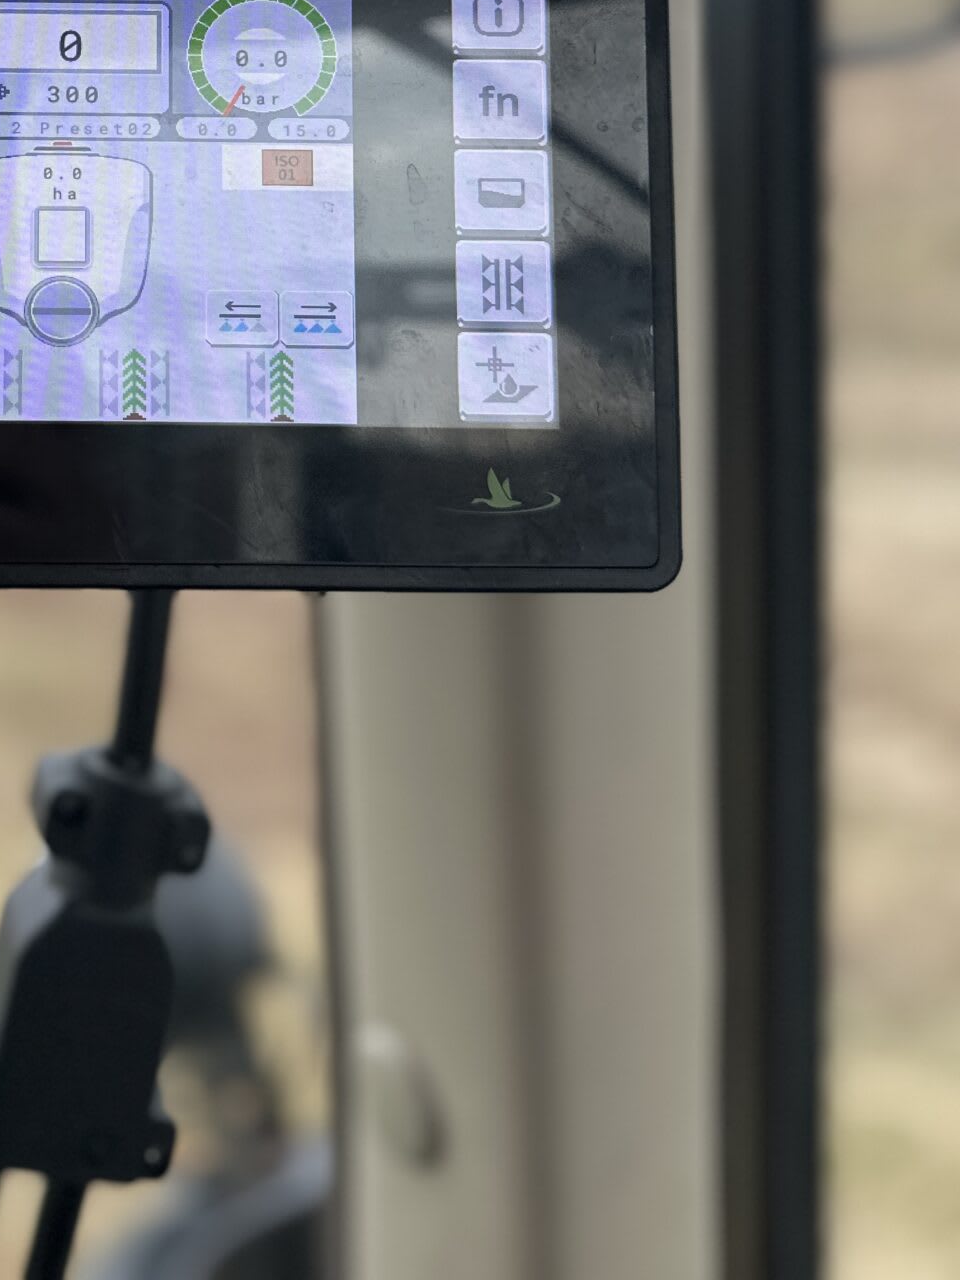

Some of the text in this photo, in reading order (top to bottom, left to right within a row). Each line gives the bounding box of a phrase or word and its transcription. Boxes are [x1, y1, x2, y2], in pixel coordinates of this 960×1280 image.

[59, 30, 82, 62] 0
[235, 50, 288, 68] 0.0
[47, 86, 99, 103] 300
[241, 93, 280, 106] bar
[478, 85, 520, 117] fn
[12, 121, 153, 136] 2 Preset02
[198, 123, 237, 137] 0.0
[283, 125, 336, 138] 15.0
[275, 155, 299, 166] ISO
[43, 167, 82, 180] 0.0
[279, 170, 296, 181] 01
[53, 187, 77, 200] ha
